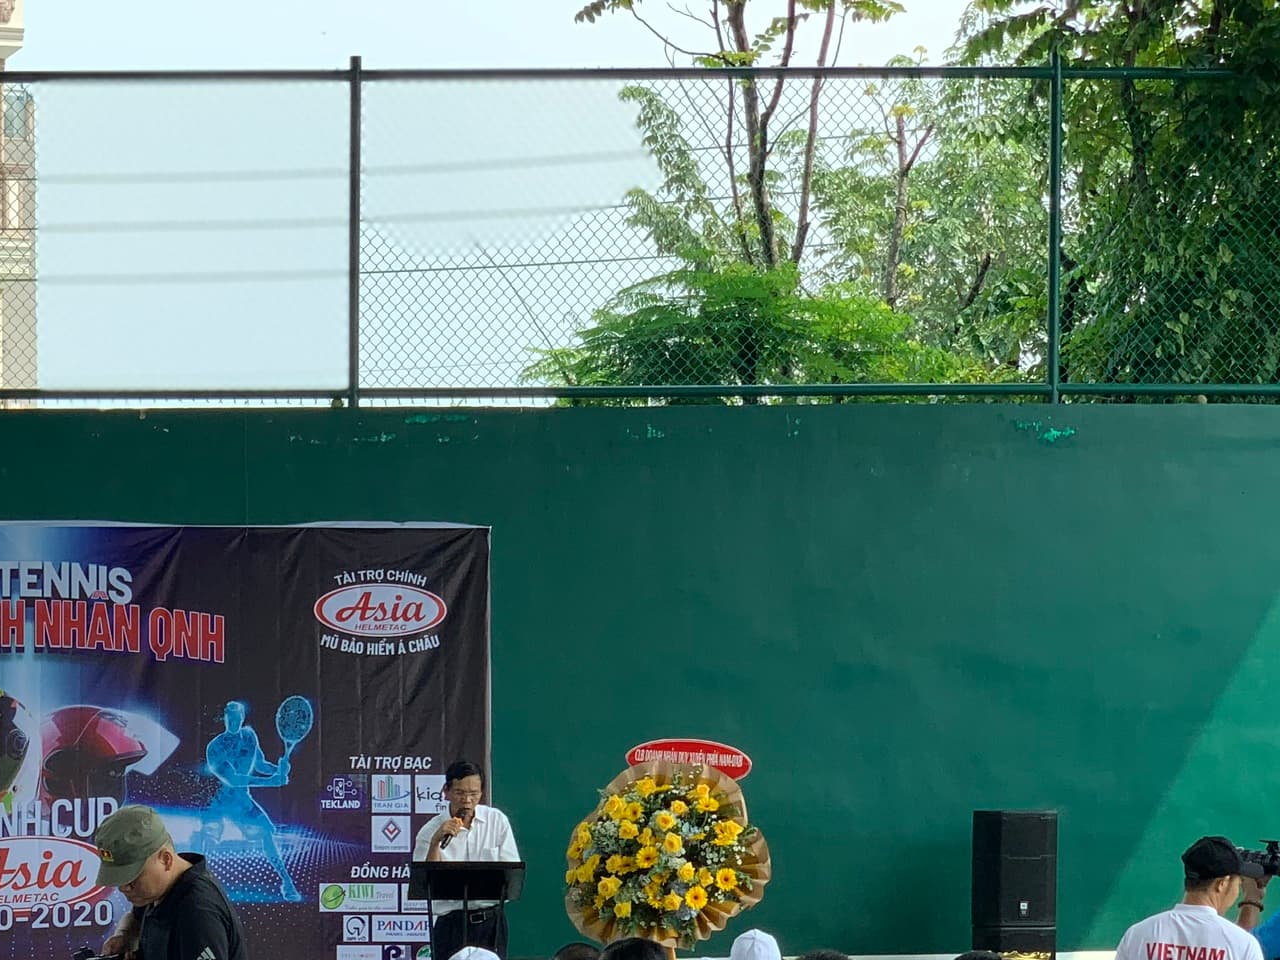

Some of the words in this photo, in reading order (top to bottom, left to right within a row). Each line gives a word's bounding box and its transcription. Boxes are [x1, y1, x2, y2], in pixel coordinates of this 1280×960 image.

[334, 570, 356, 586] TÀI
[358, 568, 385, 582] TRỢ
[387, 569, 427, 587] CHÍNH
[335, 591, 426, 622] Asia
[148, 606, 225, 663] QNH
[320, 633, 339, 650] MŨ
[341, 636, 364, 655] BẢO
[408, 634, 441, 653] CHÂU
[349, 753, 371, 770] TÀI
[374, 755, 402, 772] TRỢ
[404, 756, 433, 772] BẠC
[320, 799, 361, 809] TEKLAND
[351, 861, 389, 879] ĐỒNG
[392, 862, 411, 879] HÀ
